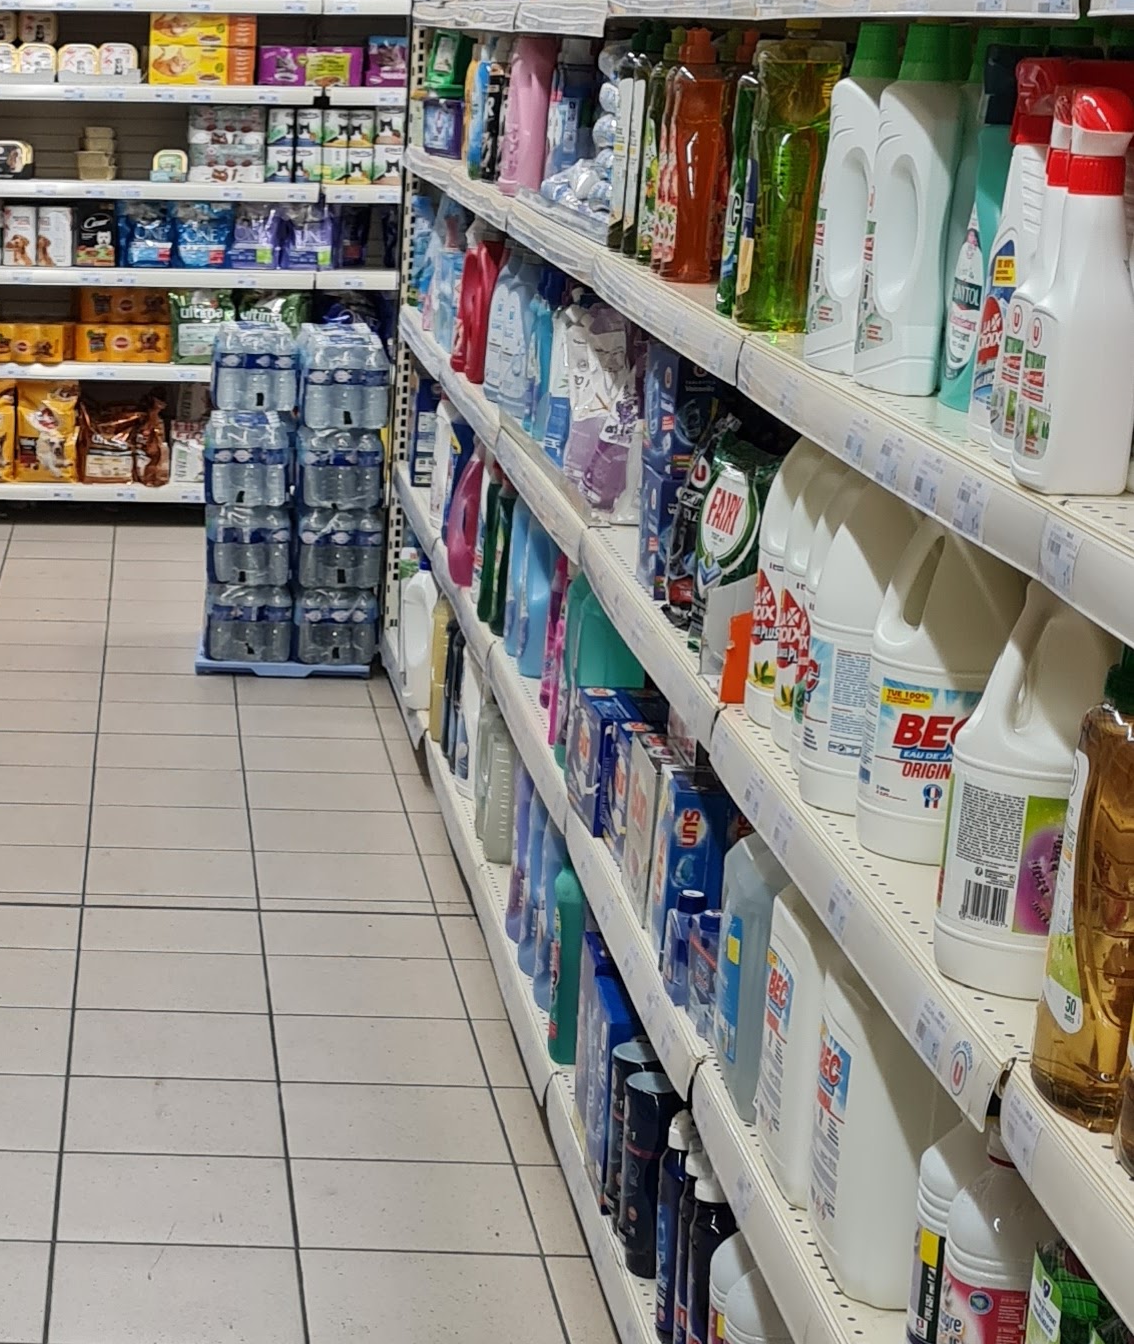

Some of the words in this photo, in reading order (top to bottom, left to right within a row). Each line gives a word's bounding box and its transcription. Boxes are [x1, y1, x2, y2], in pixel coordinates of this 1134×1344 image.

[705, 486, 745, 537] FAIRY
[887, 688, 902, 697] TUE
[904, 750, 922, 760] EAU
[926, 752, 939, 760] DE
[1065, 995, 1077, 1015] 50
